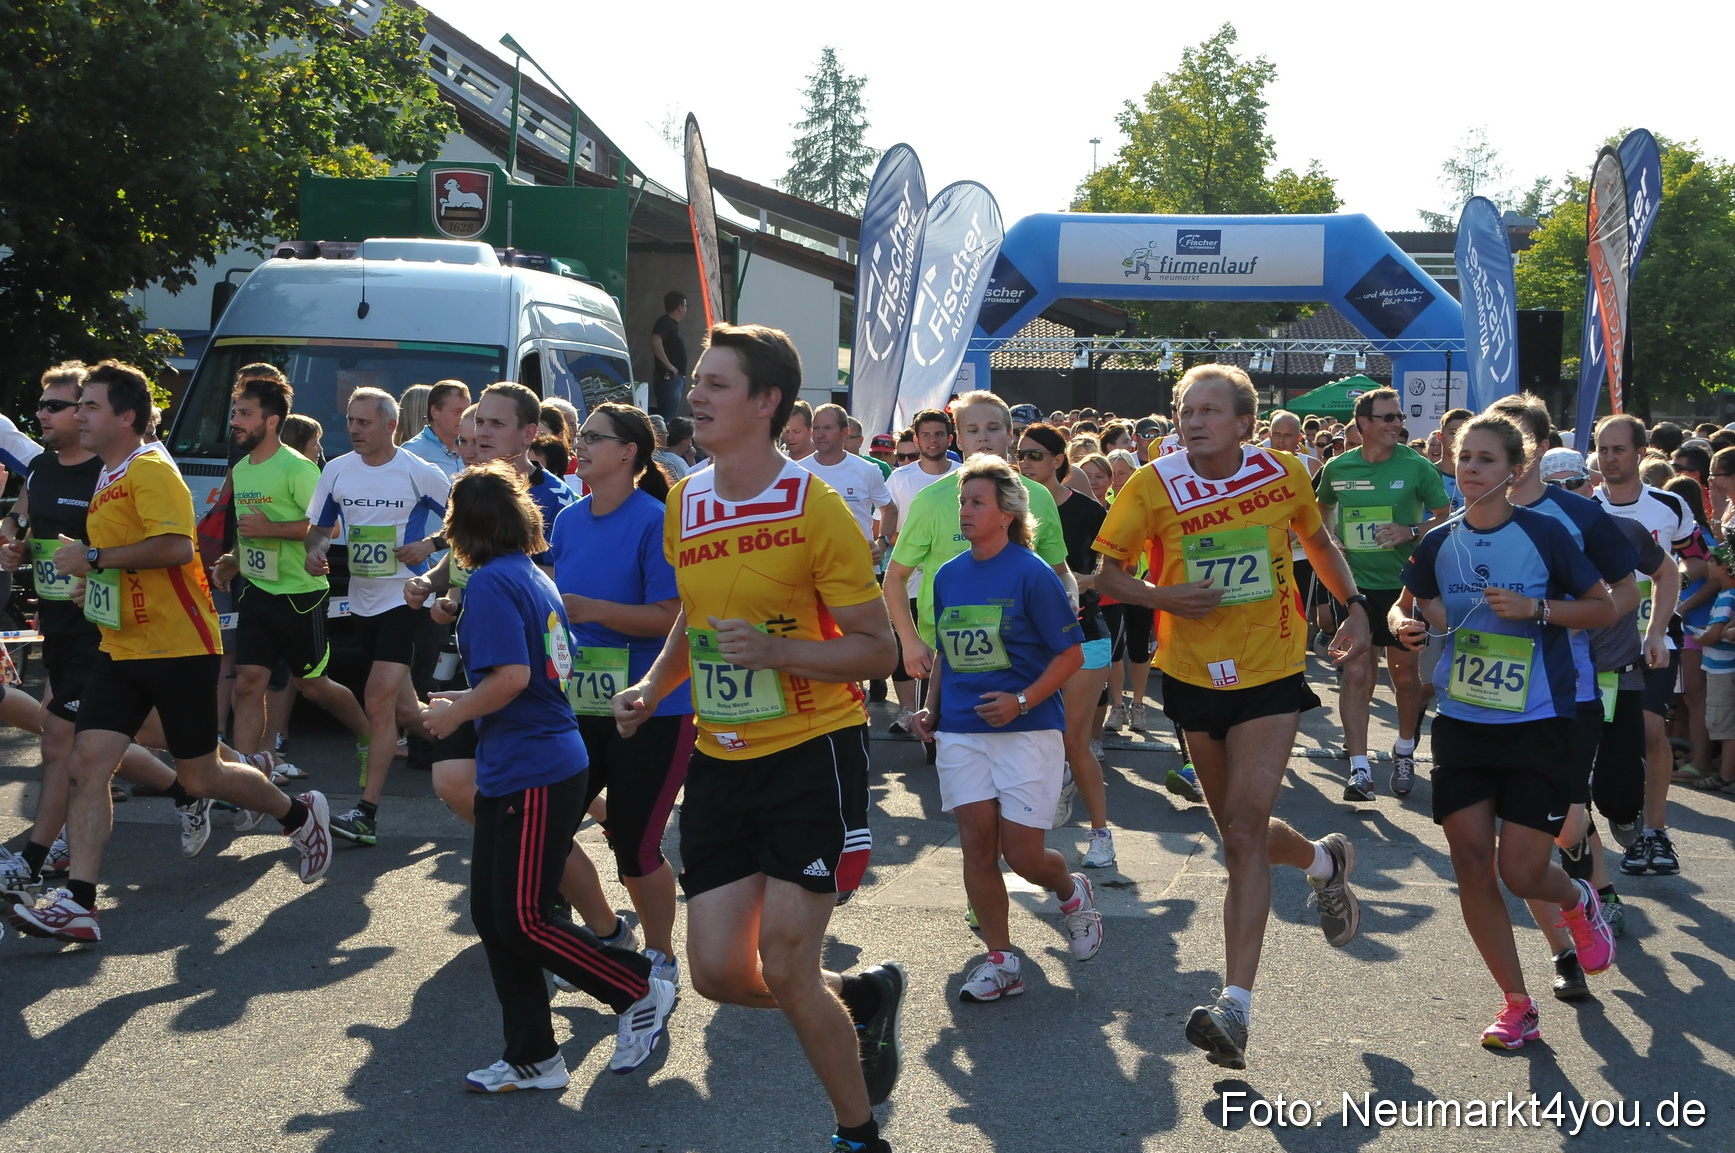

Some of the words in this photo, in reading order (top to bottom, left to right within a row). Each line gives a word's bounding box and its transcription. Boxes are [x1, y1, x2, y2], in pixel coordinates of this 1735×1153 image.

[449, 222, 474, 233] 1628
[876, 179, 912, 334] Fischer
[1185, 239, 1219, 247] Fischer
[896, 210, 918, 333] AUTOMOBILE
[929, 211, 982, 345] Fischer
[1160, 256, 1258, 275] firmenlauf
[985, 287, 1026, 297] scher
[342, 498, 404, 508] DELPHI
[1180, 506, 1234, 536] MAX
[1237, 485, 1296, 516] BÖGL
[246, 548, 267, 570] 38
[352, 543, 388, 564] 226
[678, 539, 730, 569] MAX
[737, 527, 806, 554] BÖGL
[1195, 554, 1260, 589] 772
[88, 579, 111, 612] 761
[946, 629, 994, 656] 723
[572, 672, 616, 699] 719
[698, 663, 754, 701] 757
[1454, 653, 1526, 693] 1245
[803, 867, 831, 877] adidas
